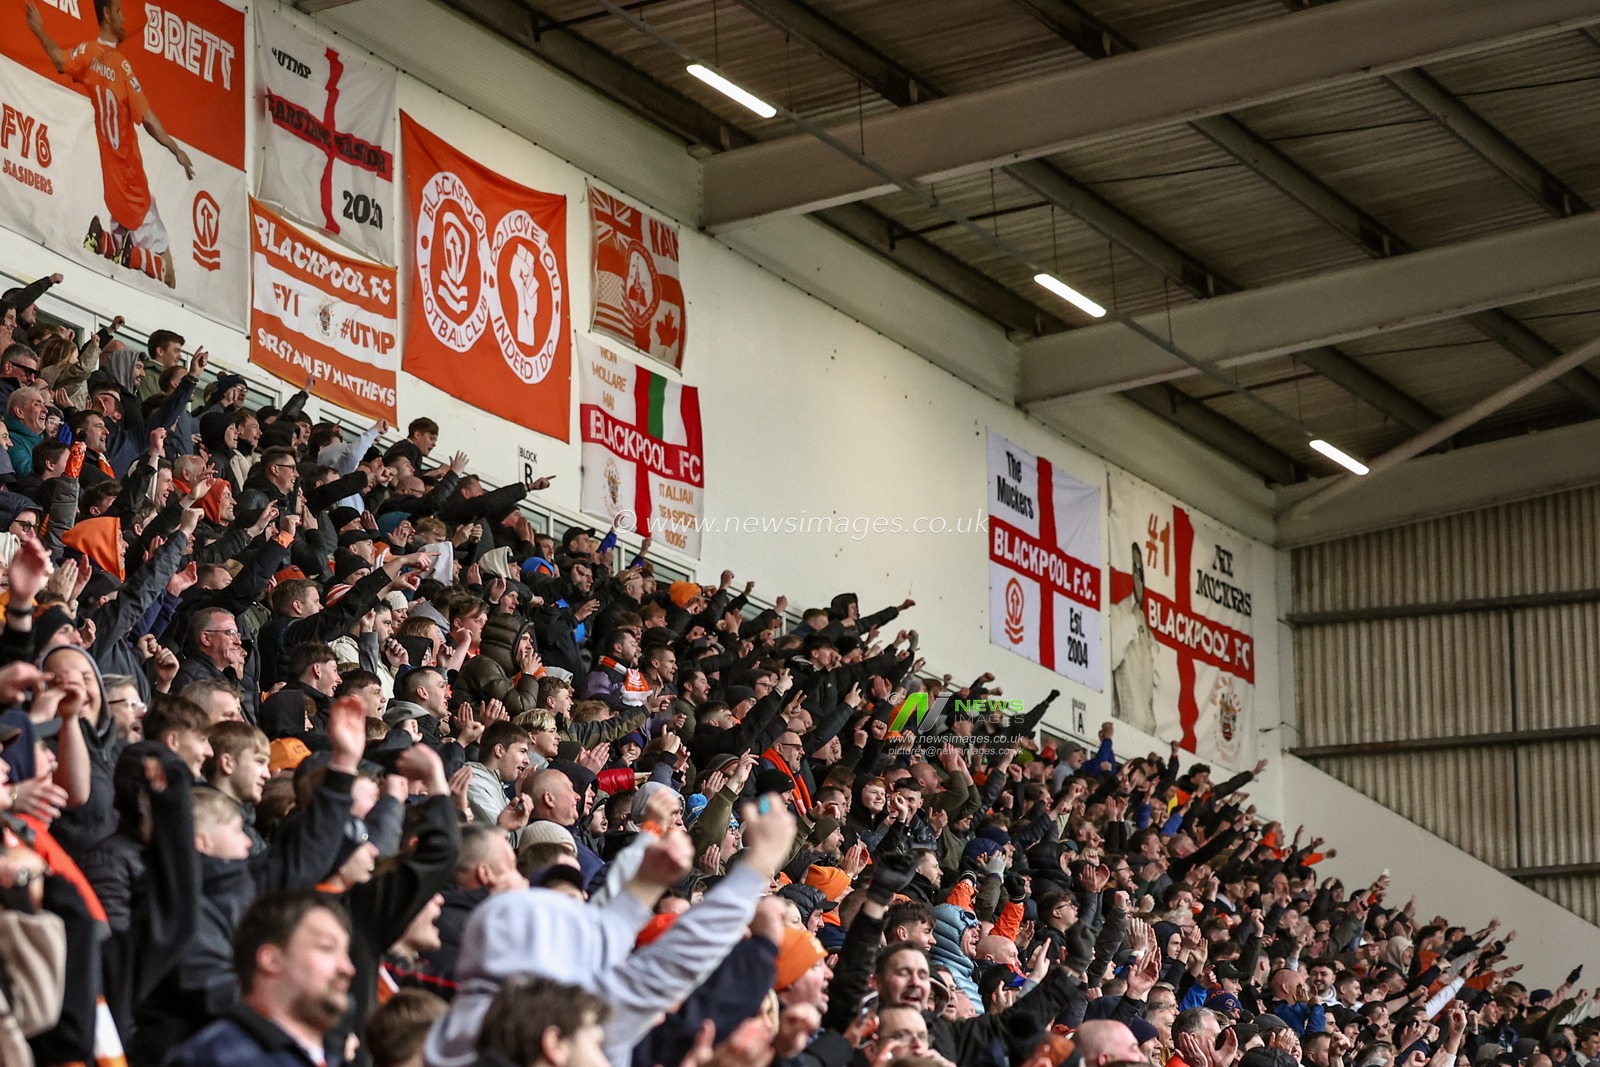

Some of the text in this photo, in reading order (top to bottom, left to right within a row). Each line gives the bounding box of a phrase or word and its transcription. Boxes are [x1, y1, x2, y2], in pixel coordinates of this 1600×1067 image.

[144, 2, 236, 91] BRETT
[95, 84, 120, 150] 10
[423, 175, 487, 251] BLACKPOOL
[509, 215, 541, 244] LOVE
[254, 214, 392, 305] BLACKPOOL FC
[340, 317, 395, 355] #UTMP
[421, 264, 487, 348] FOOTBALL CLUB
[279, 341, 331, 380] STANLEY
[333, 369, 396, 407] MATTHEWS
[494, 315, 533, 379] INDEED
[540, 339, 553, 373] DO
[519, 447, 538, 464] BLOCK
[590, 409, 701, 483] BLACKPOOL FC
[1006, 451, 1022, 483] The
[997, 475, 1034, 520] Muckers
[993, 527, 1072, 592] BLACKPOOL
[1145, 513, 1170, 577] #1
[1068, 635, 1089, 669] 2004
[1148, 597, 1250, 671] BLACKPOOL FC
[1077, 712, 1085, 735] A
